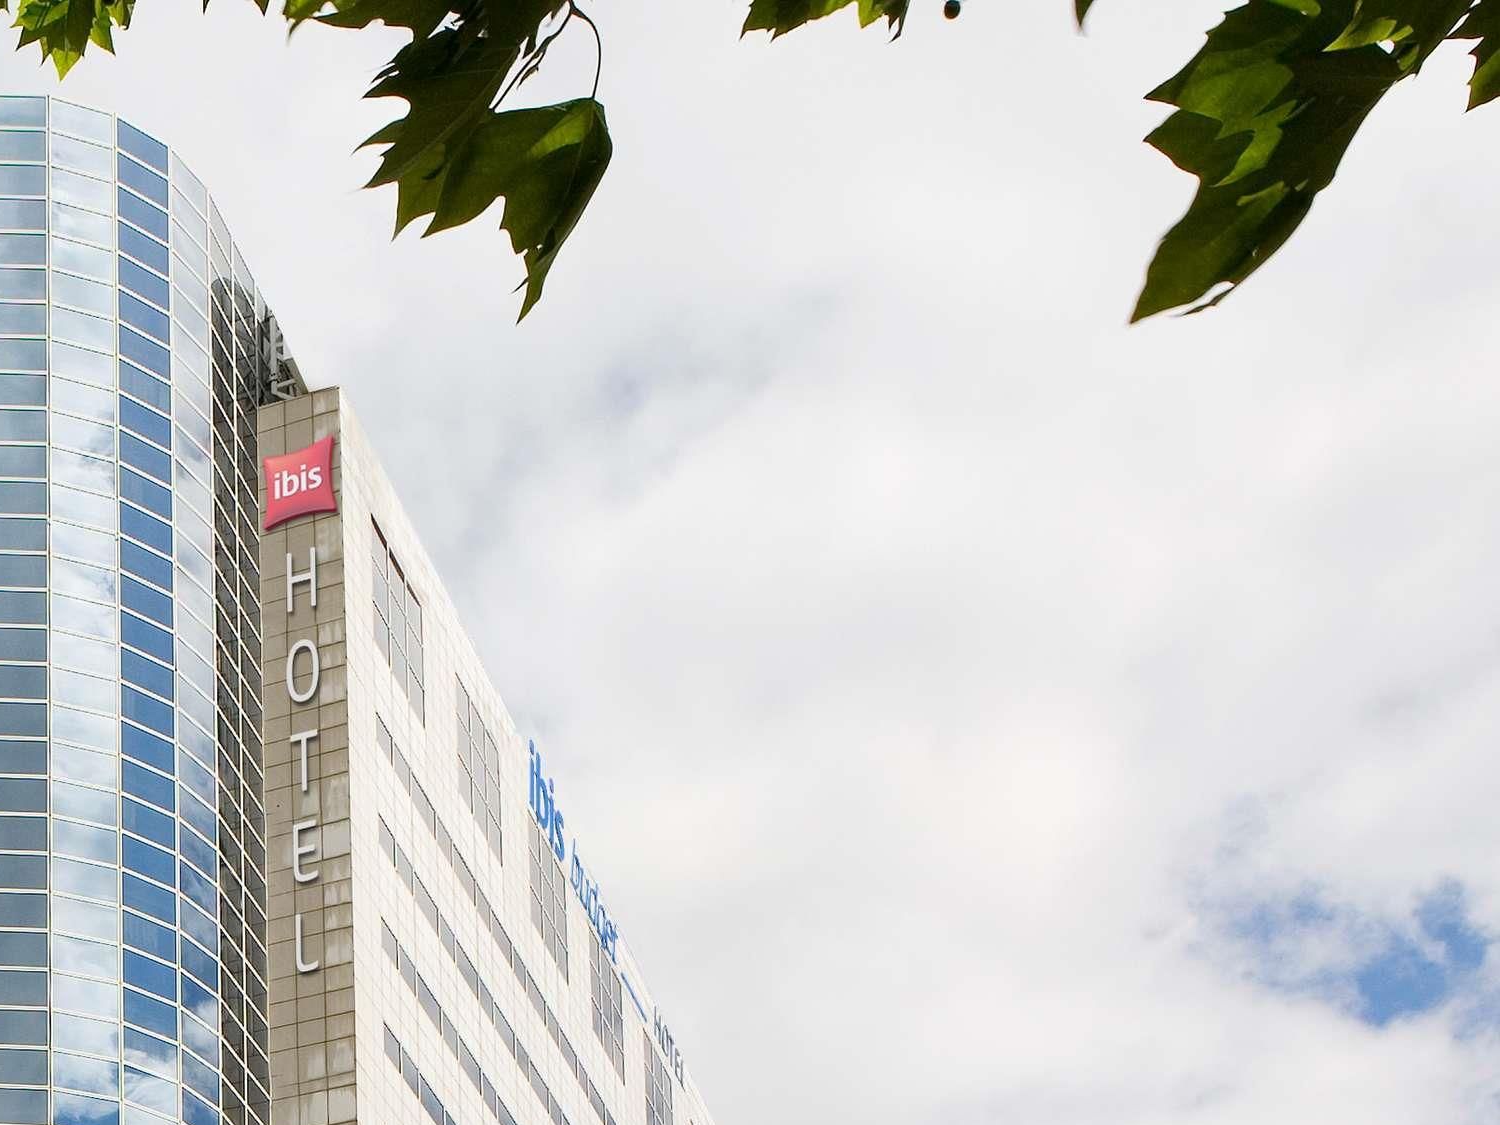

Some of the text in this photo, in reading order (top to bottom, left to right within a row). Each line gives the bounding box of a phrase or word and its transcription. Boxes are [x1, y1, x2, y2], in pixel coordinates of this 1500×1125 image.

[274, 464, 323, 500] ibis
[285, 546, 319, 974] HOTEL
[529, 739, 565, 862] ibis
